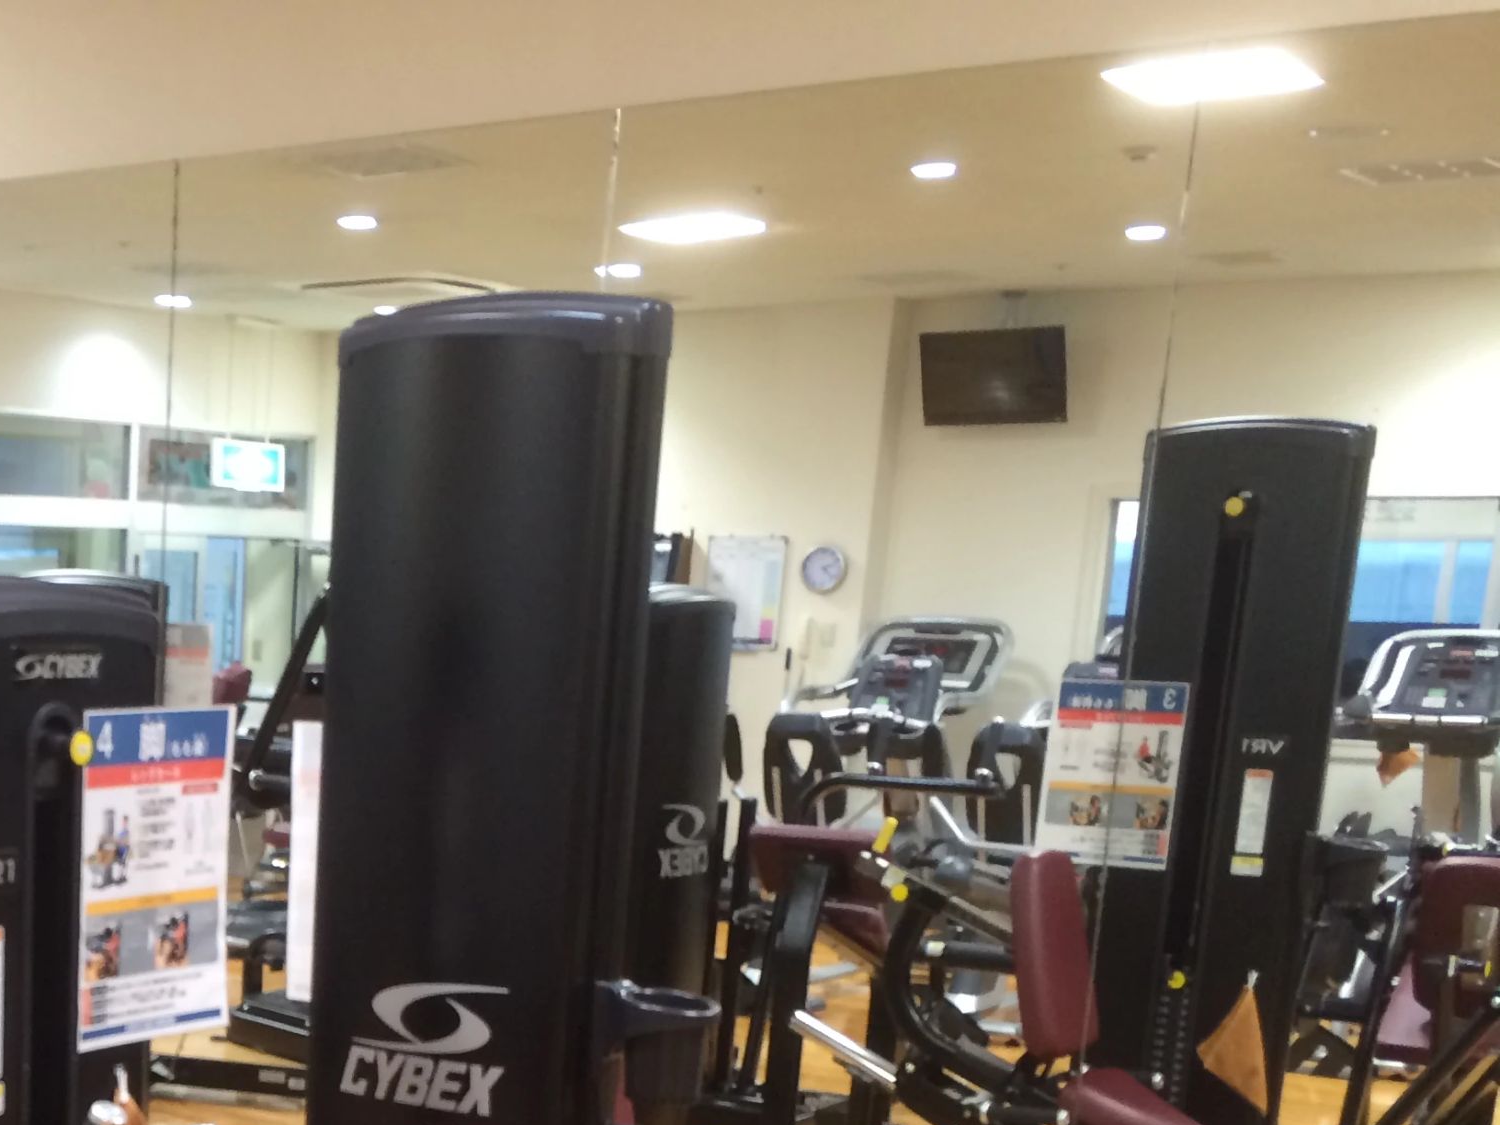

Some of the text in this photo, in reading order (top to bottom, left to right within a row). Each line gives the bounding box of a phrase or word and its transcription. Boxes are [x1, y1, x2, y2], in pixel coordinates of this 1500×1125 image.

[48, 653, 102, 679] CYBEX
[96, 720, 114, 760] 4
[339, 1044, 505, 1118] CYBEX
